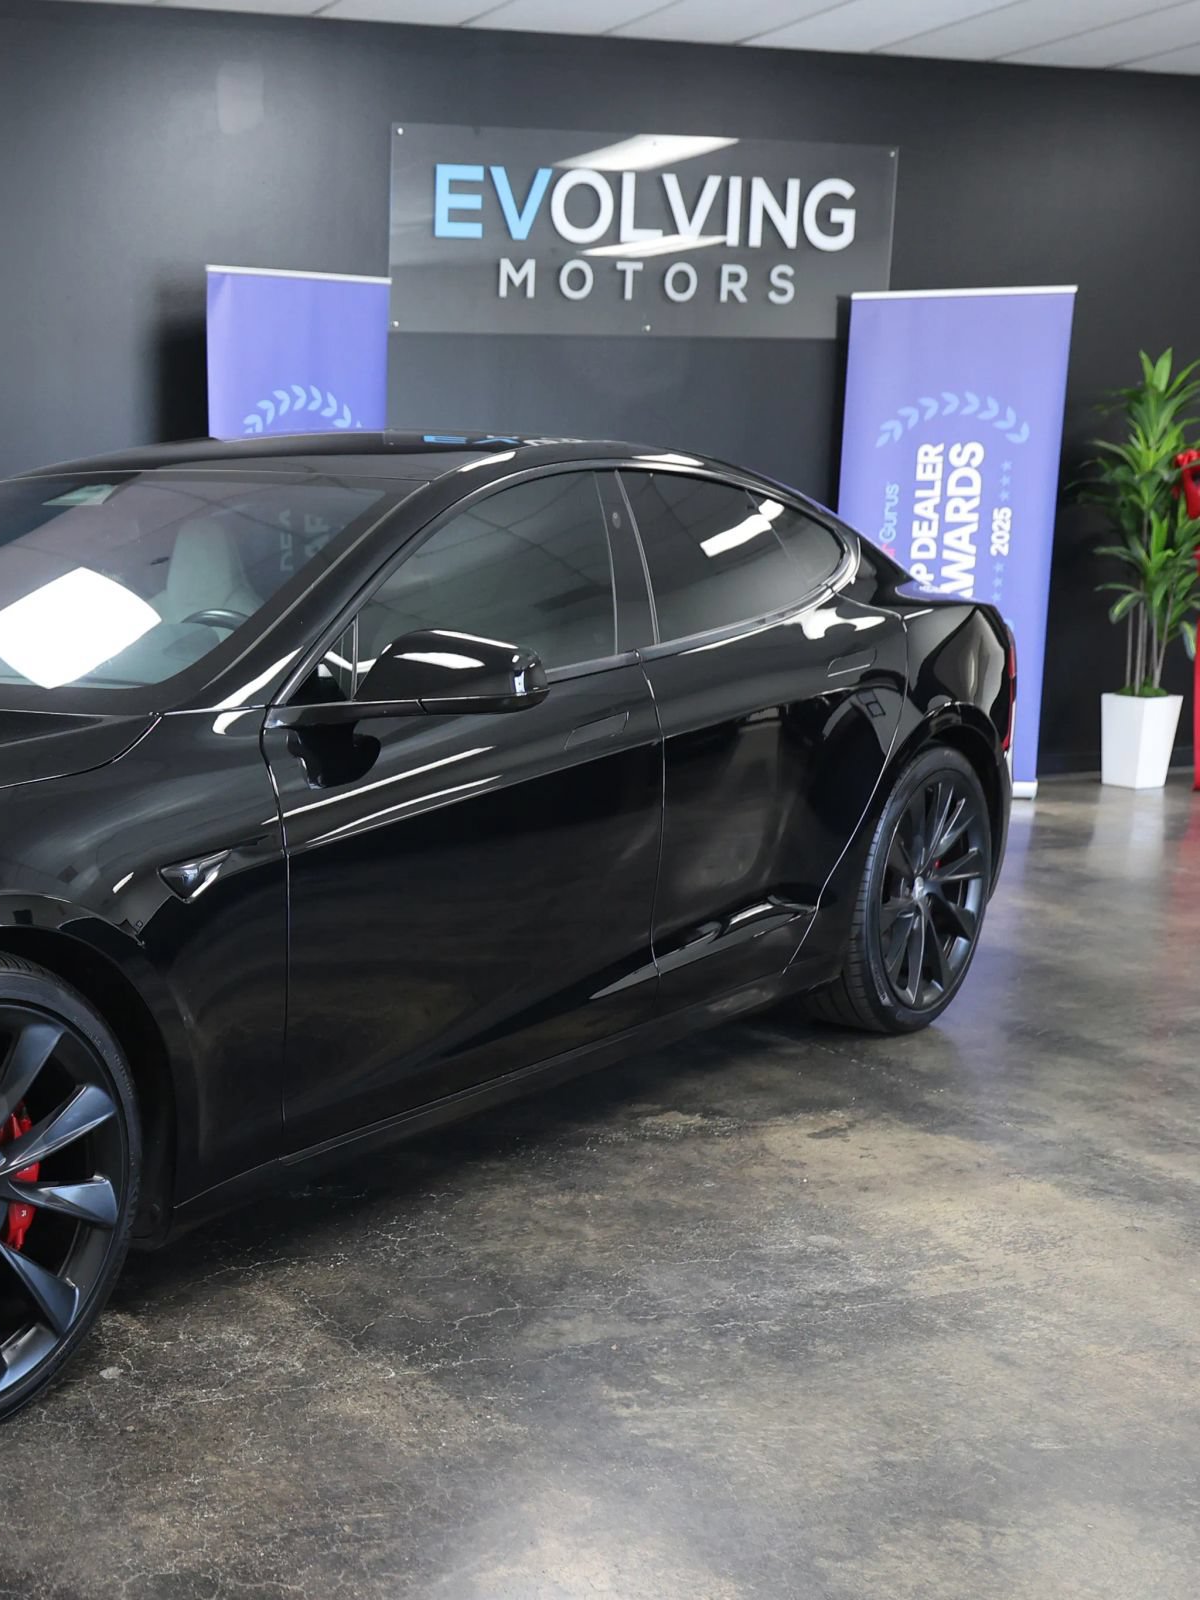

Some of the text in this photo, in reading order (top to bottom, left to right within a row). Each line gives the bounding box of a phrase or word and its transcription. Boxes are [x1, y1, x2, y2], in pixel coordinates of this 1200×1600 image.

[433, 162, 857, 252] EVOLVING
[499, 257, 796, 305] MOTORS
[990, 507, 1012, 556] 2025
